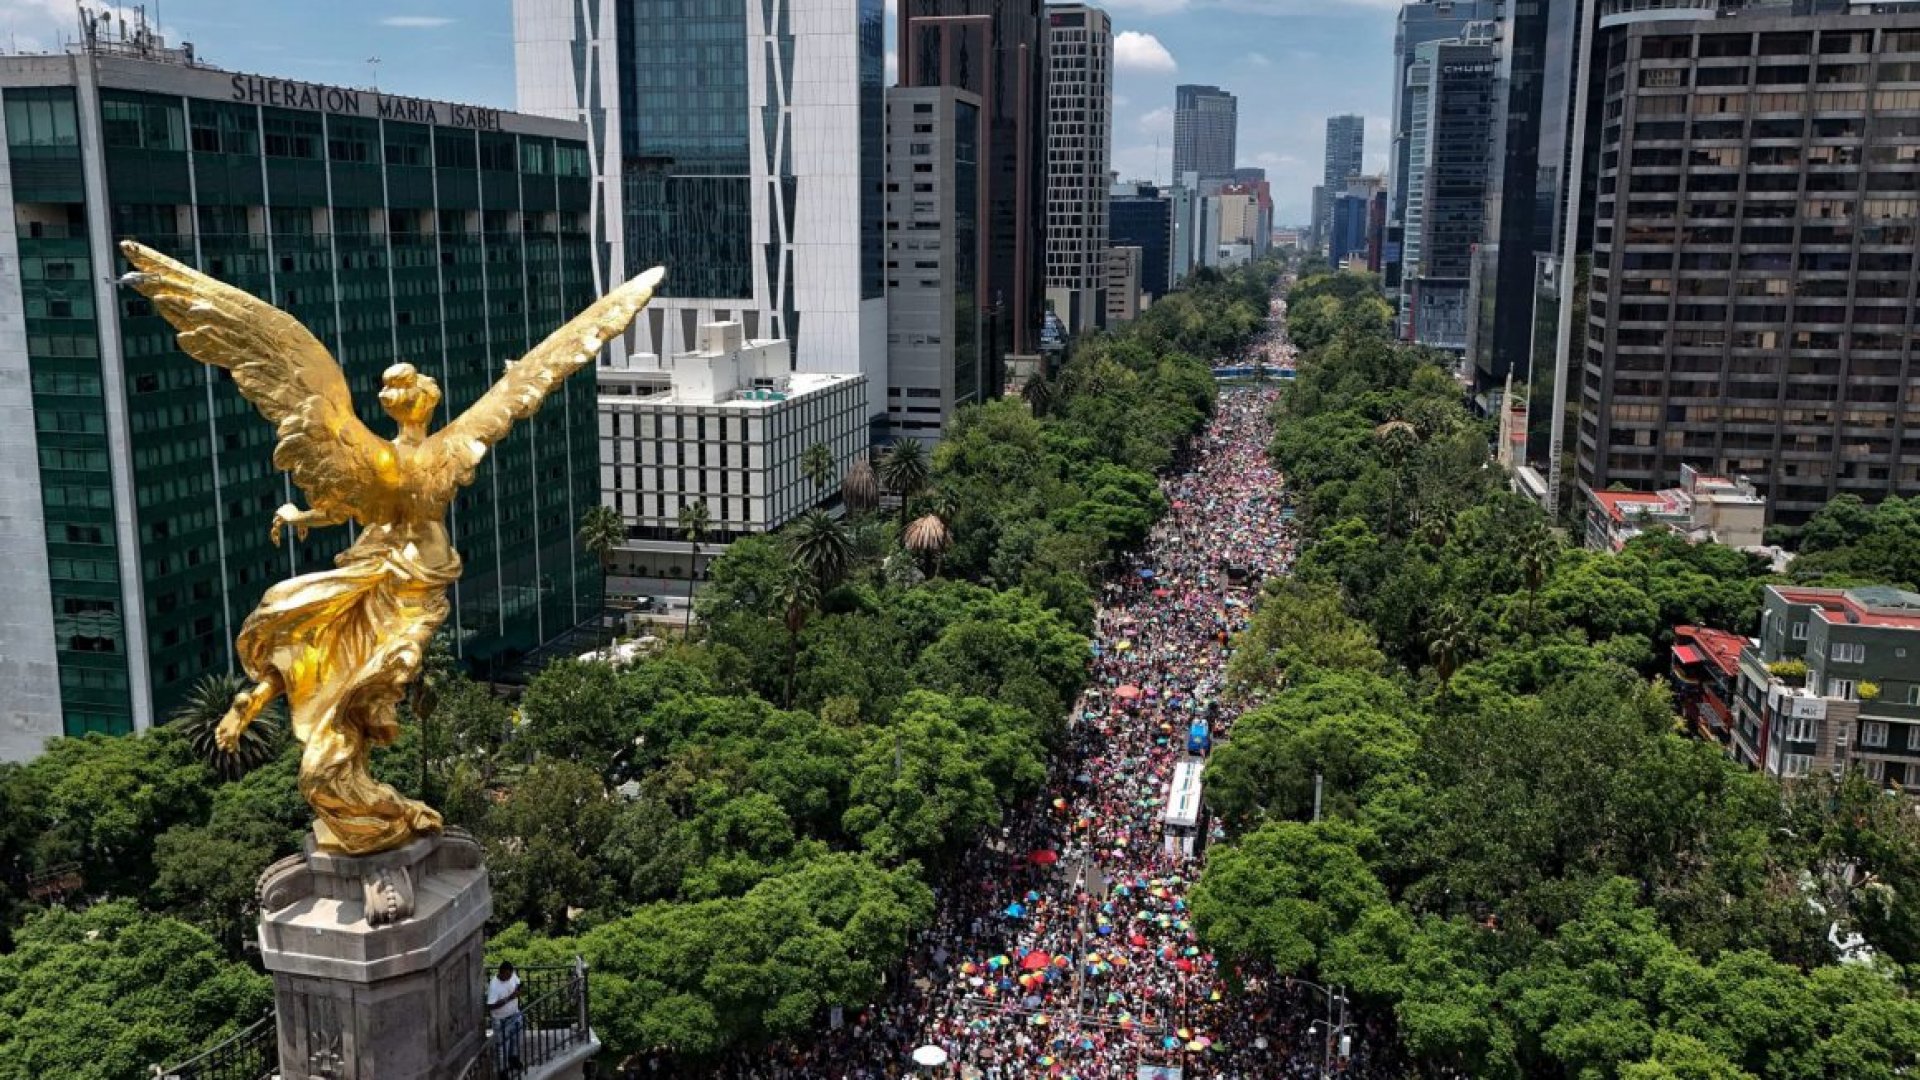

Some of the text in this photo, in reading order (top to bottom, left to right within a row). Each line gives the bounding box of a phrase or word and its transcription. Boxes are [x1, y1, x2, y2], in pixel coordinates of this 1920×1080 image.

[231, 75, 504, 132] SHERATON MARIA ISABEL
